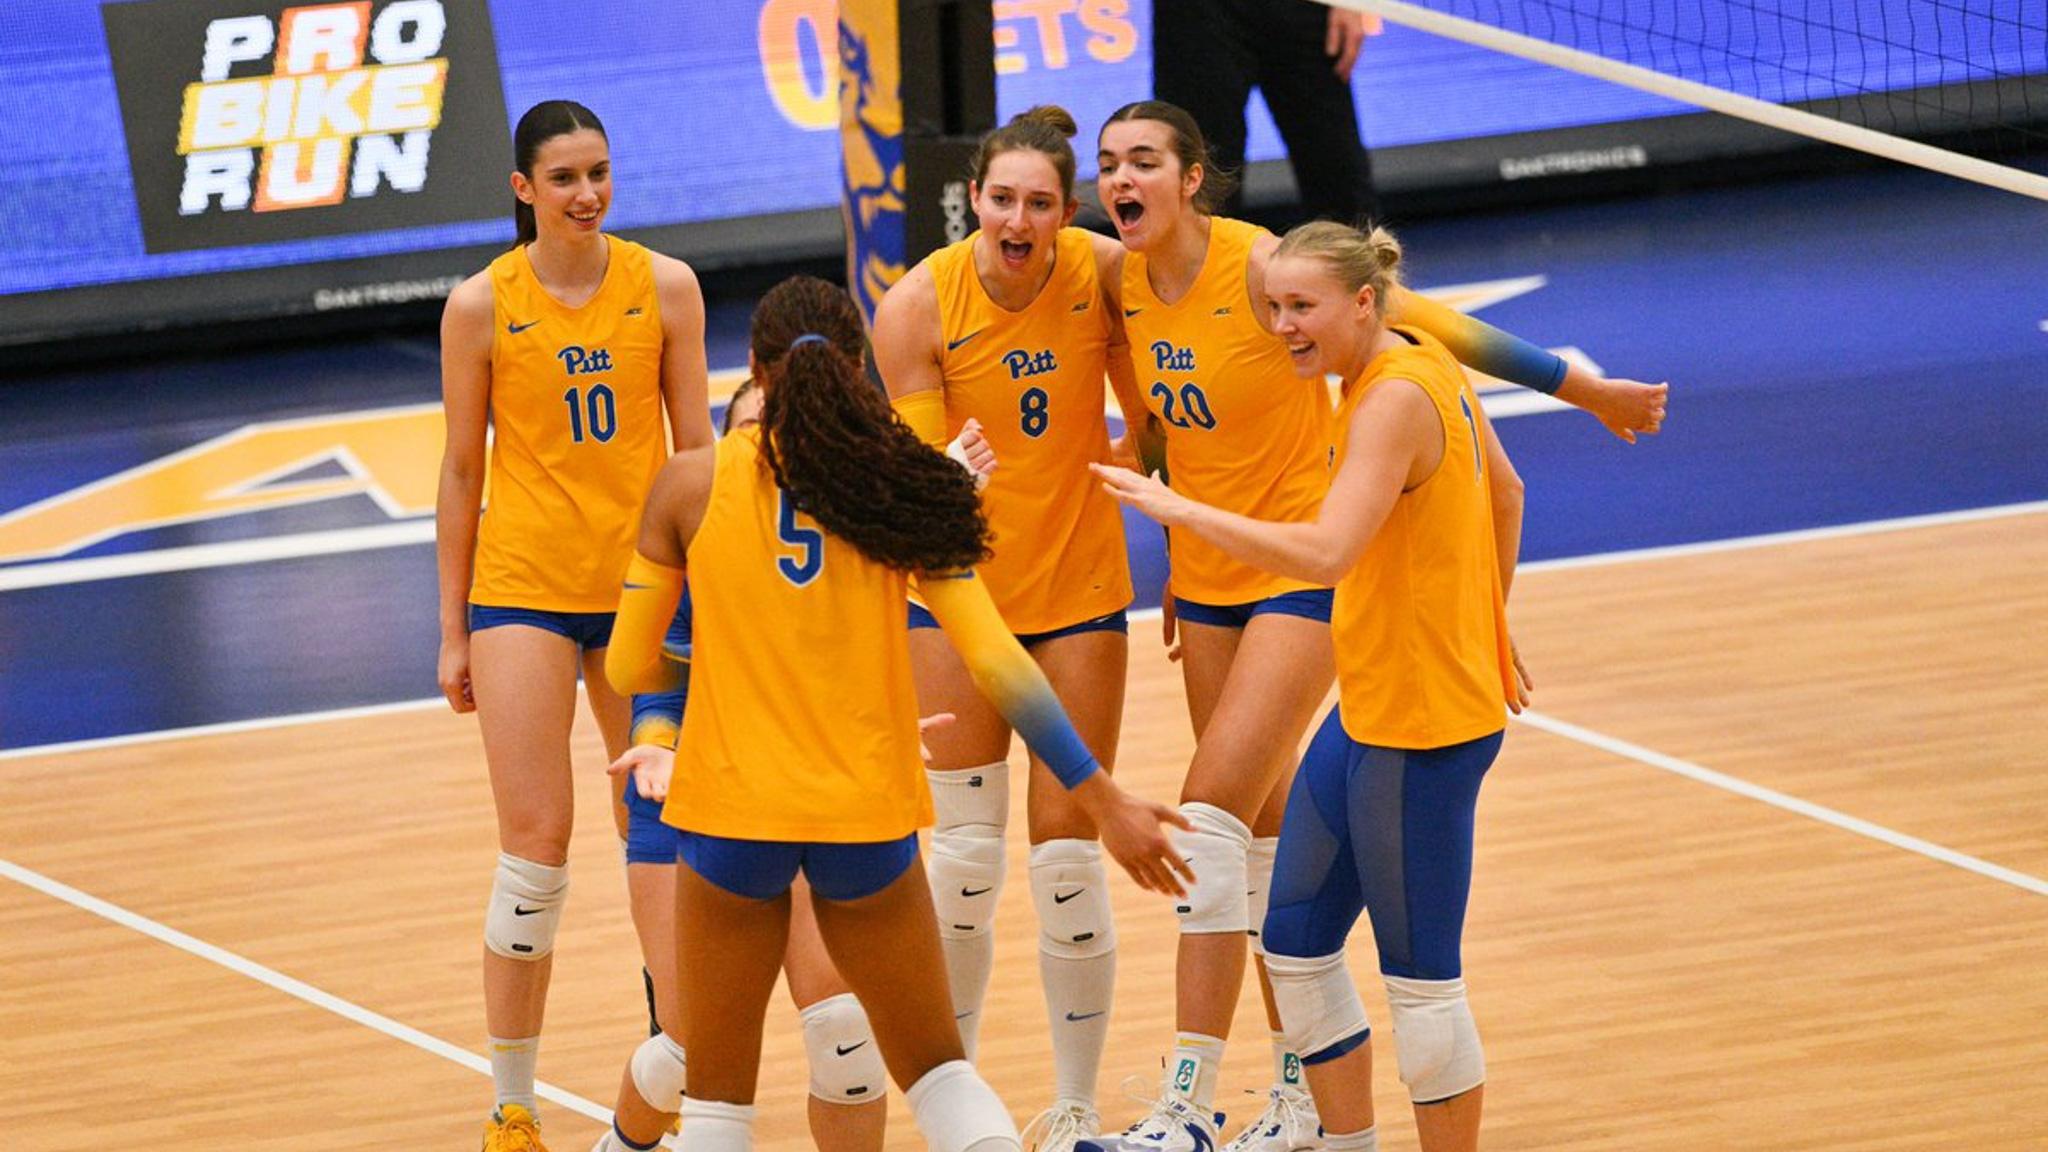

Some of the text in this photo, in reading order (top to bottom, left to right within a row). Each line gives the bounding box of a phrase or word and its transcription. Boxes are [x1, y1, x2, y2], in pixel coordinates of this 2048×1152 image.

[201, 0, 447, 82] PRO
[192, 65, 437, 149] BIKE
[179, 129, 432, 215] RUN
[557, 345, 614, 376] Pitt
[1001, 349, 1058, 379] Pitt
[1150, 340, 1196, 371] Pitt
[564, 383, 617, 443] 10
[1019, 387, 1049, 438] 8
[1151, 381, 1217, 430] 20
[776, 486, 825, 588] 5
